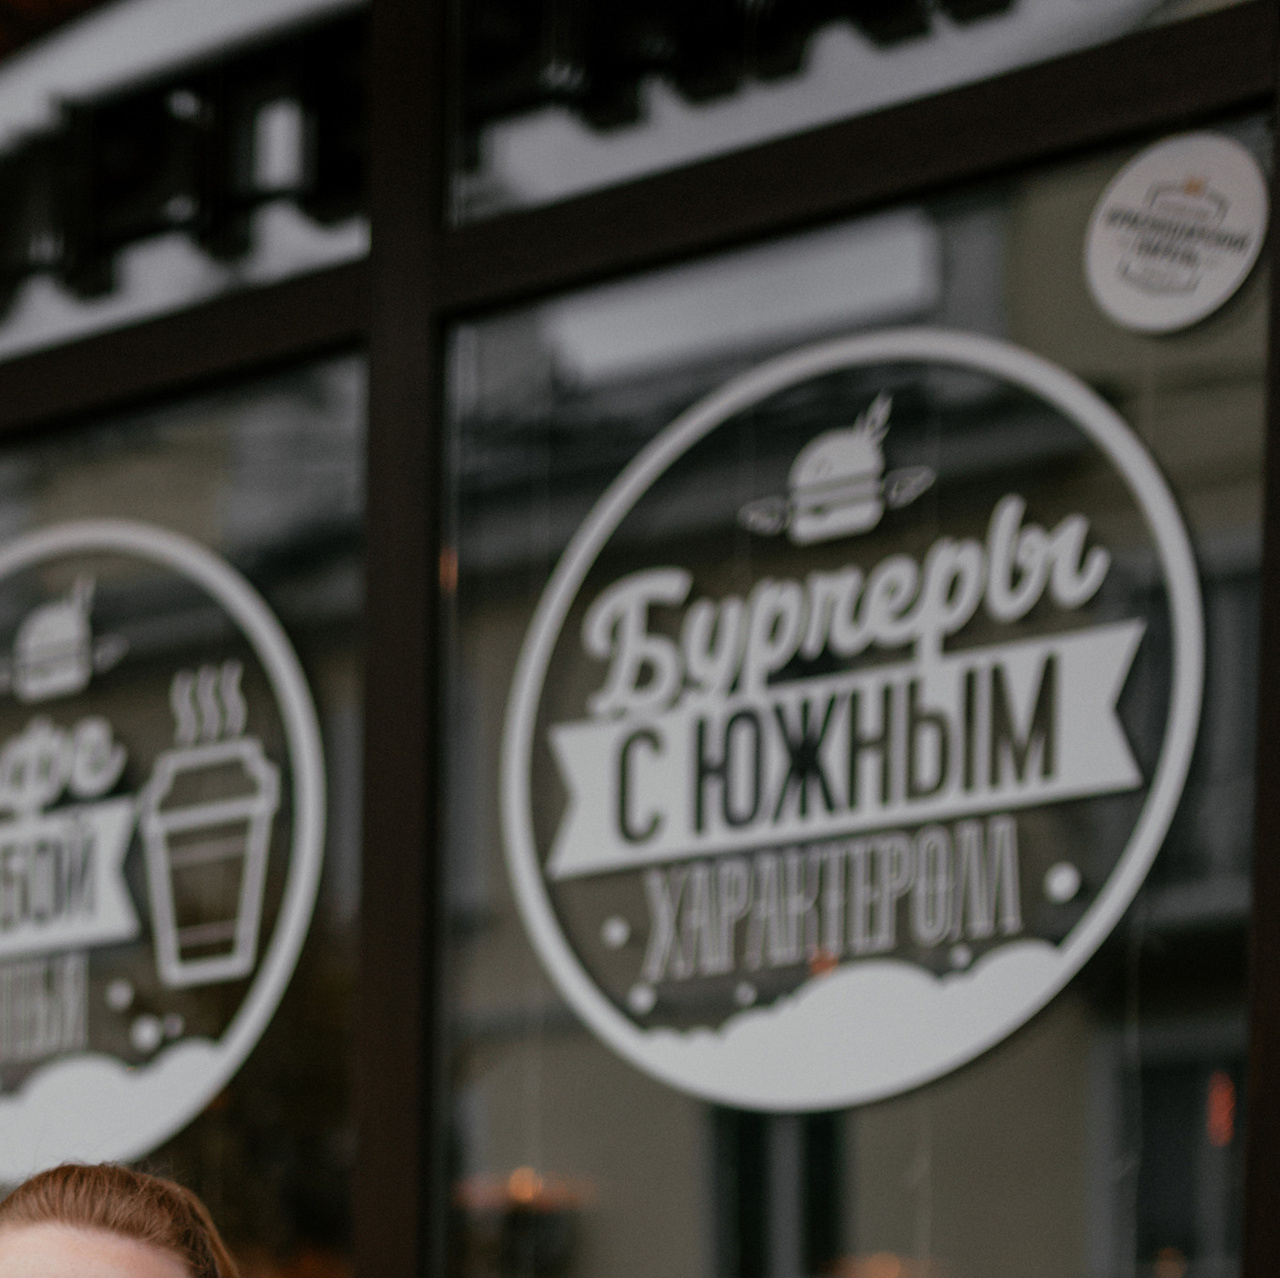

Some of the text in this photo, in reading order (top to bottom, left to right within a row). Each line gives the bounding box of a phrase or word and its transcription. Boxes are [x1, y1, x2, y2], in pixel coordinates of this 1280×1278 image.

[584, 494, 1111, 720] Бургеры
[614, 649, 1060, 845] С ЮЖНЫМ
[641, 814, 1023, 982] ХАРАКТЕРОМ
